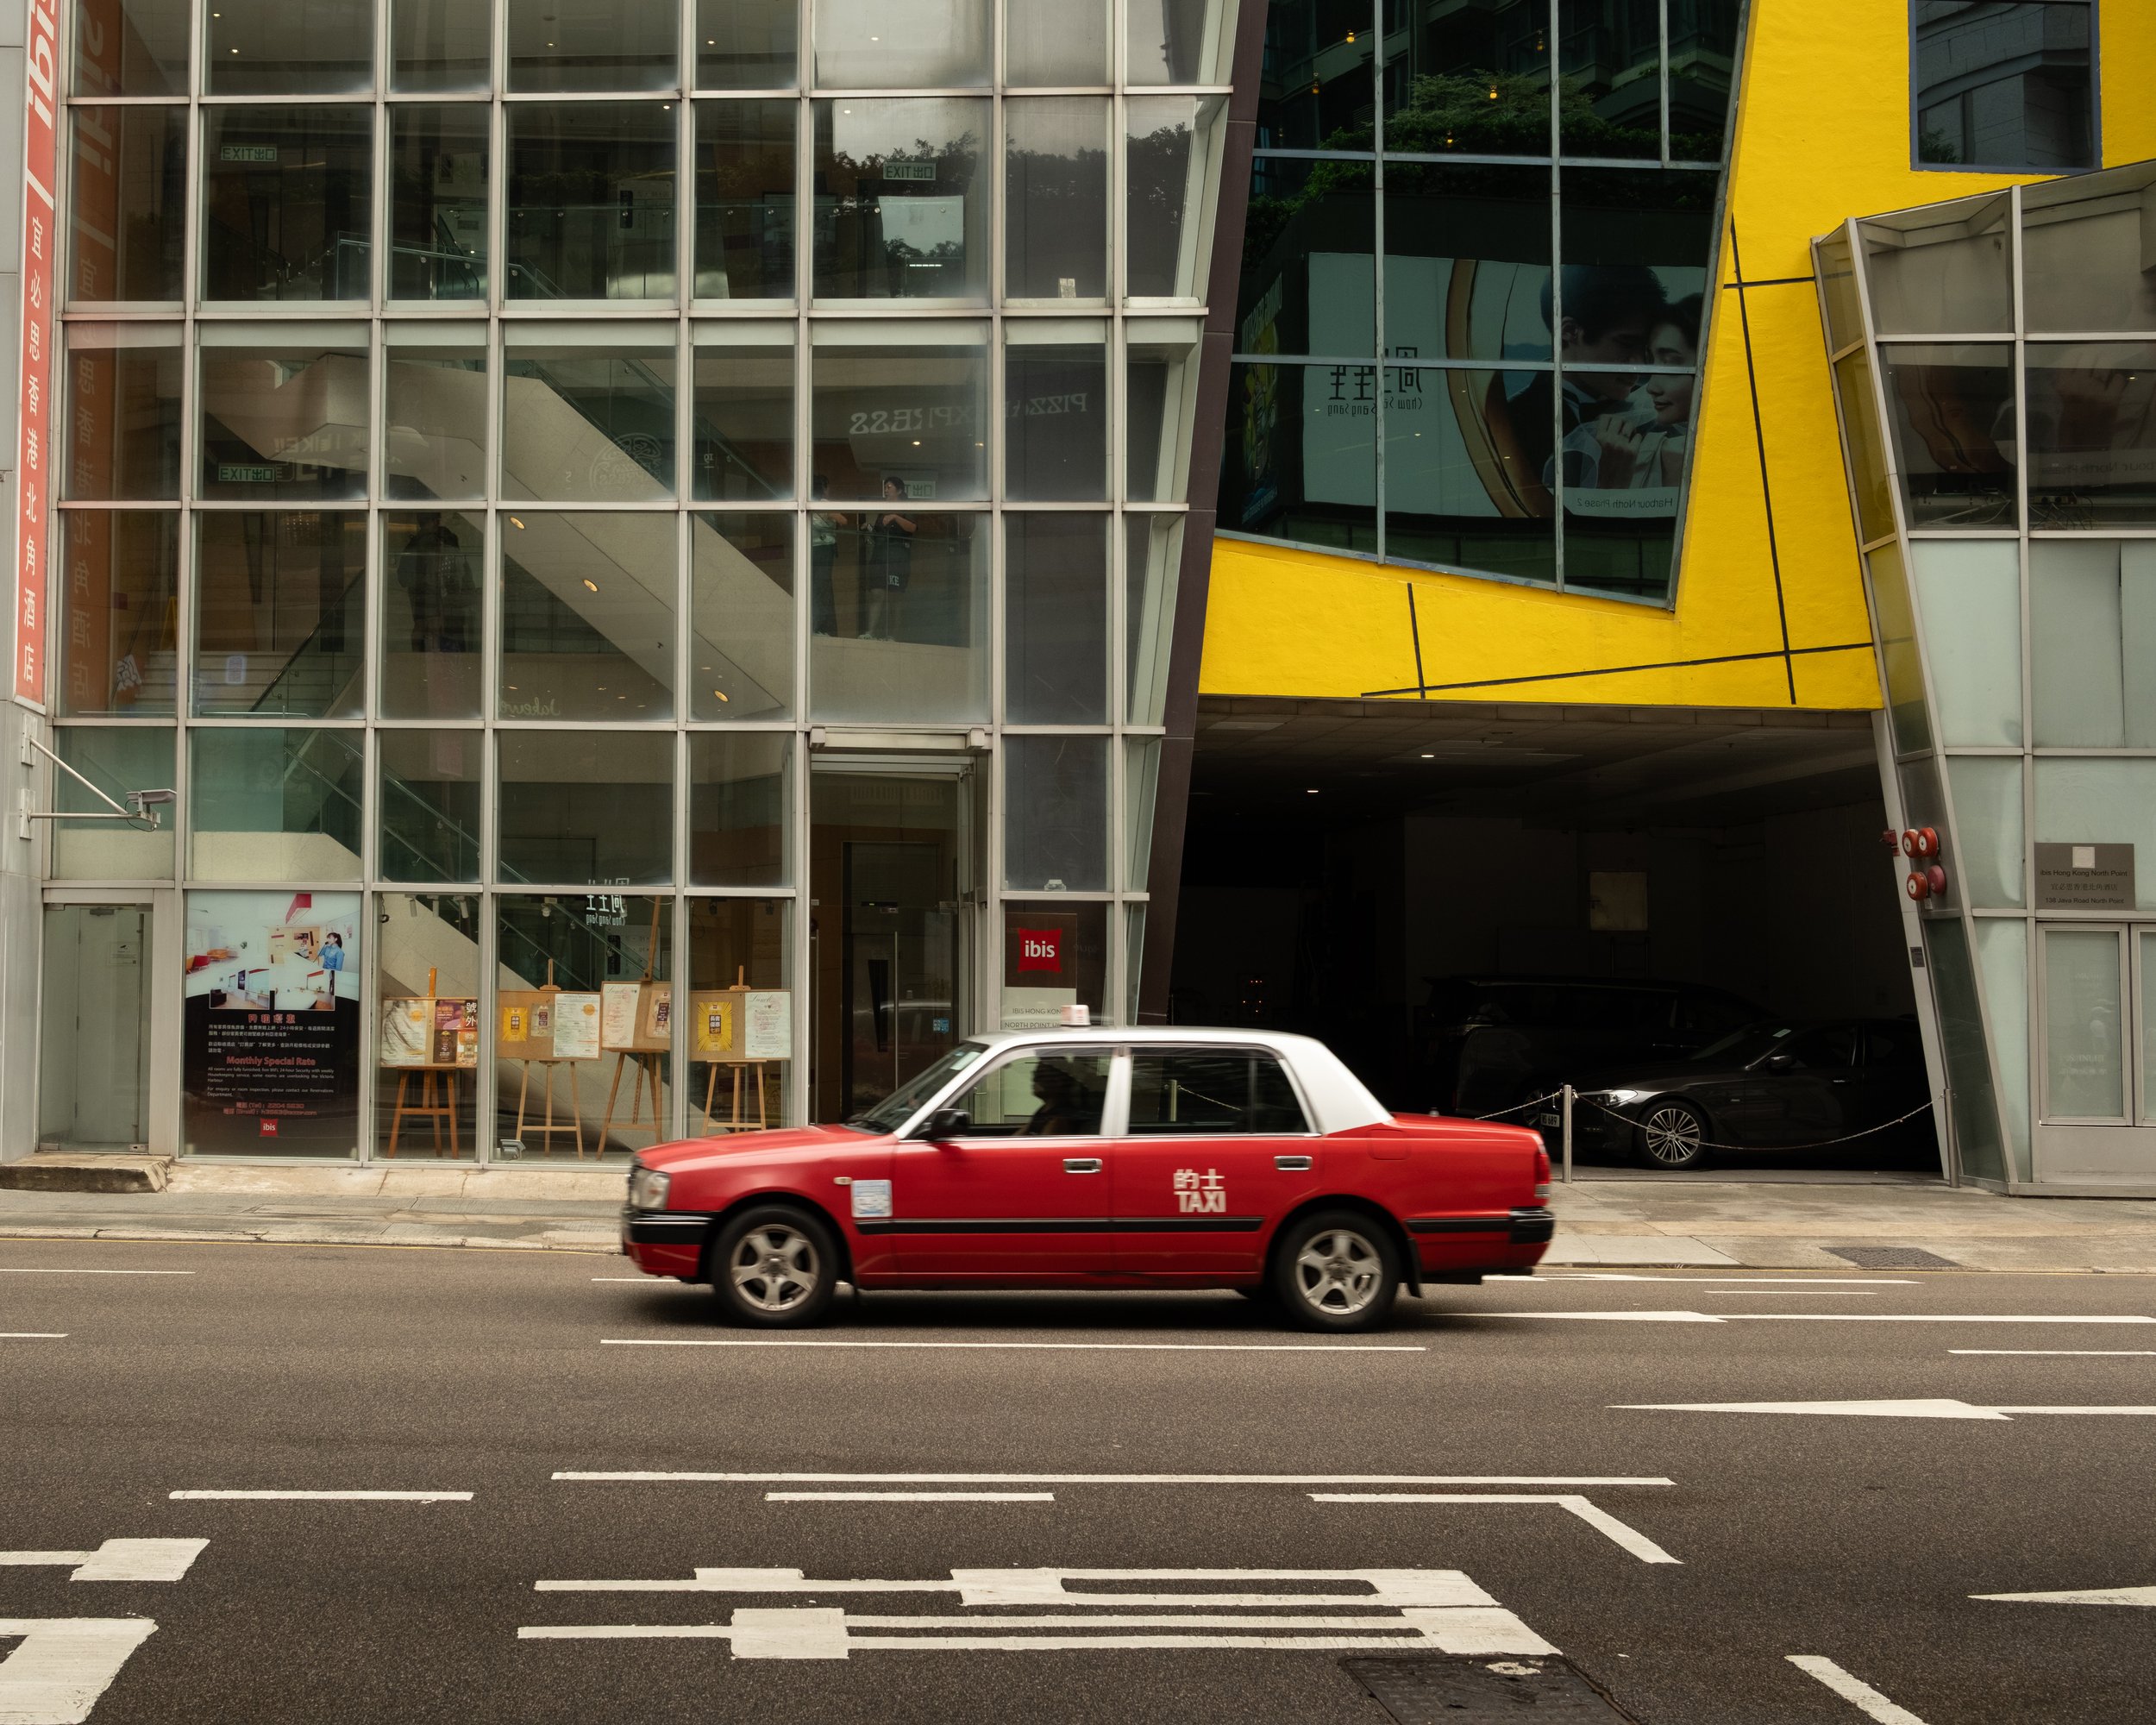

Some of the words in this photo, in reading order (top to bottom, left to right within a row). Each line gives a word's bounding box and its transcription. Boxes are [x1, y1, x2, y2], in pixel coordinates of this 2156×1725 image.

[222, 147, 254, 160] EXIT
[254, 148, 275, 160] 出口
[886, 164, 911, 177] EXIT
[913, 166, 933, 178] 出口
[23, 216, 43, 684] 宜必思香港北角酒店
[220, 468, 251, 480] EXIT
[252, 468, 273, 481] 出口
[1025, 940, 1055, 958] ibis
[227, 1056, 262, 1066] Monthly
[264, 1057, 294, 1066] Special
[1173, 1168, 1225, 1189] 的士
[1174, 1190, 1227, 1213] TAXI
